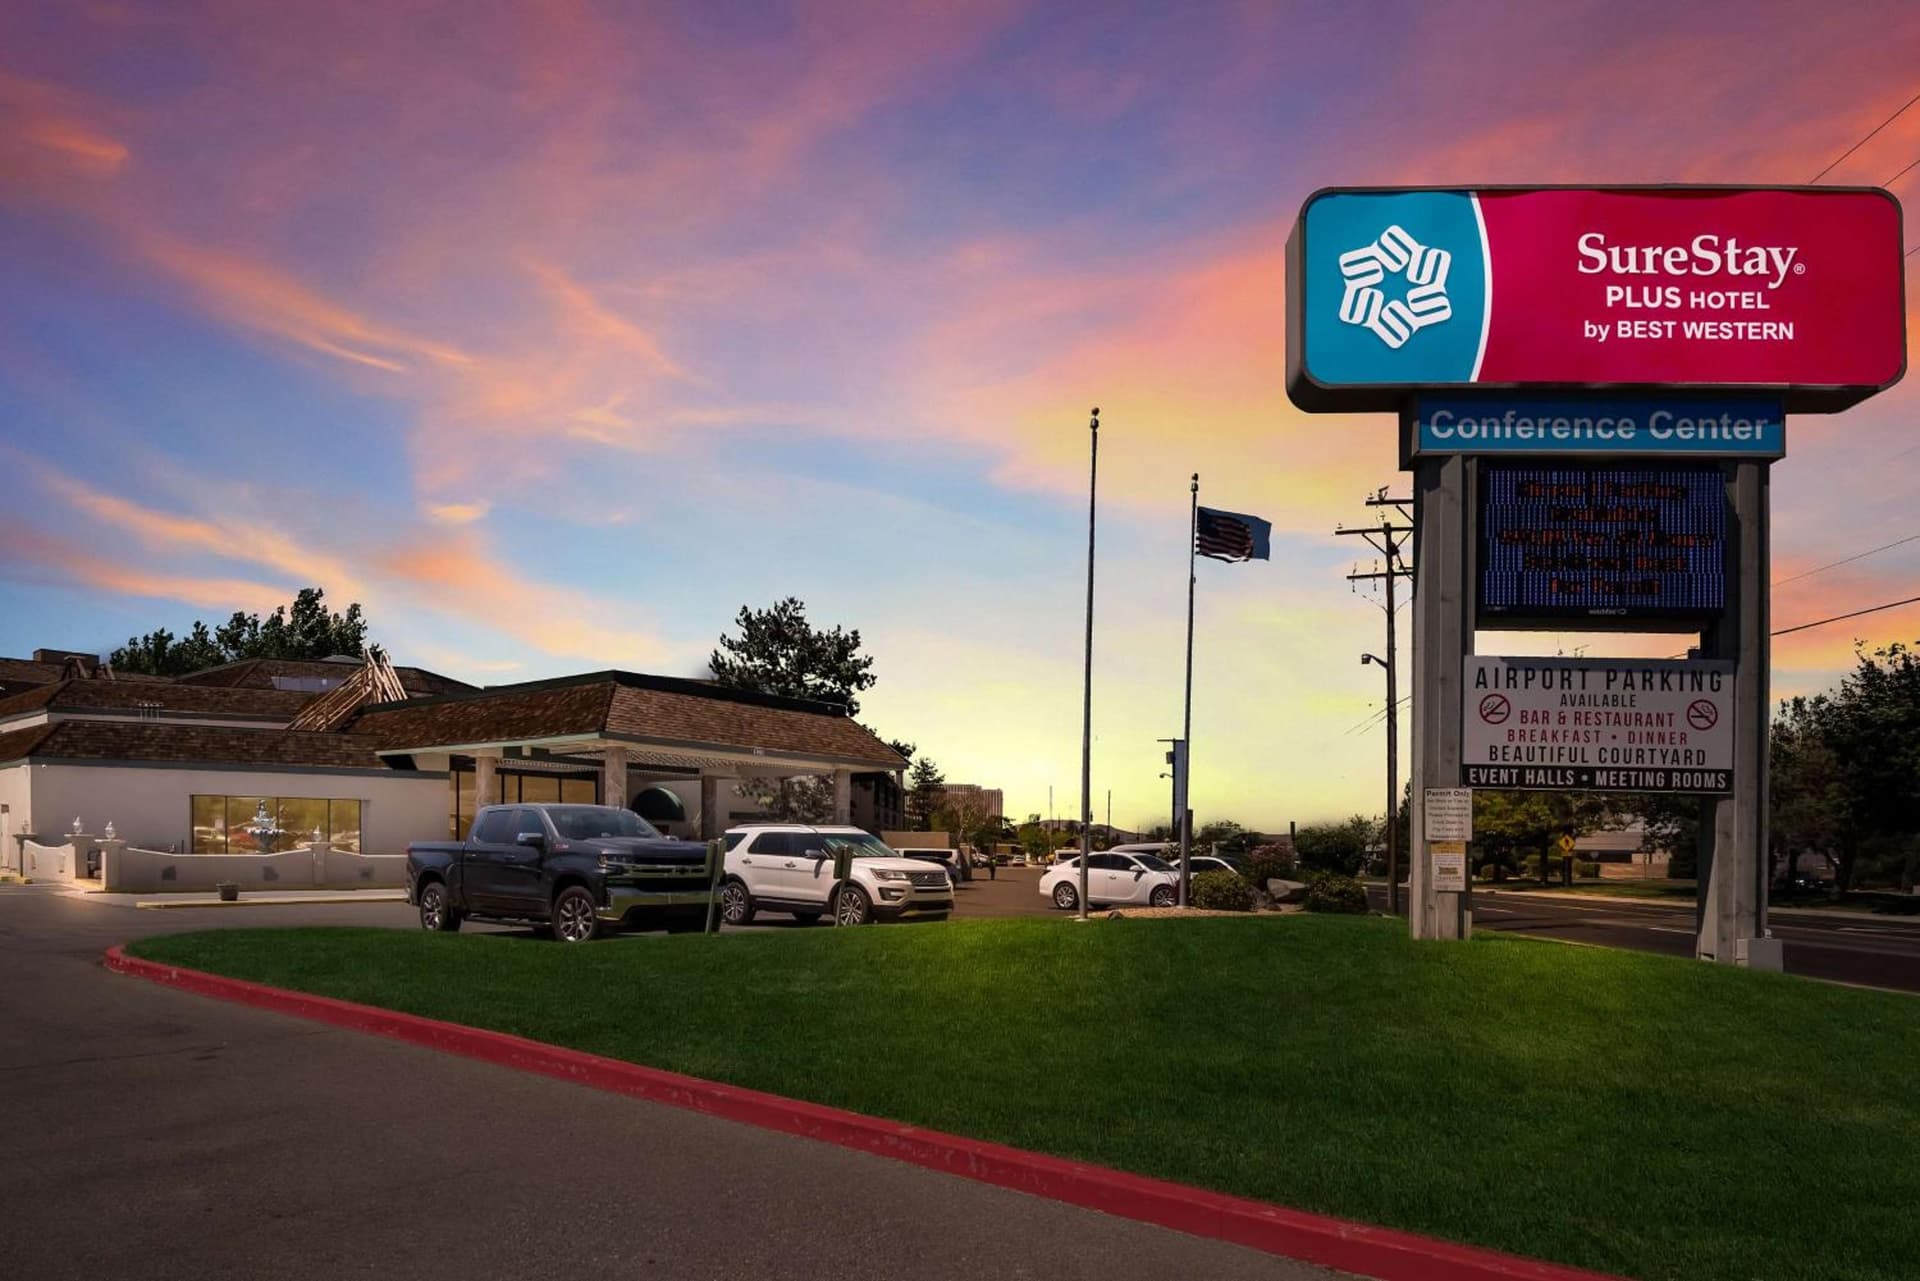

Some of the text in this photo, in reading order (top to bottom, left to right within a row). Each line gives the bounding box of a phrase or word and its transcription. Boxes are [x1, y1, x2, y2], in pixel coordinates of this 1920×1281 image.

[1606, 285, 1770, 310] PLUS HOTEL
[1584, 320, 1794, 342] by BEST WESTERN
[1430, 409, 1768, 441] Conference Center
[1475, 666, 1723, 693] AIRPORT PARKING
[1559, 693, 1637, 708] AVAILABLE
[1520, 709, 1675, 728] BAR & RESTAURANT
[1507, 728, 1688, 746] BREAKFAST DINNER
[1488, 744, 1706, 766] BEAUTIFUL COURTYARD
[1469, 768, 1727, 789] EVENT HALLS MEETING ROOMS
